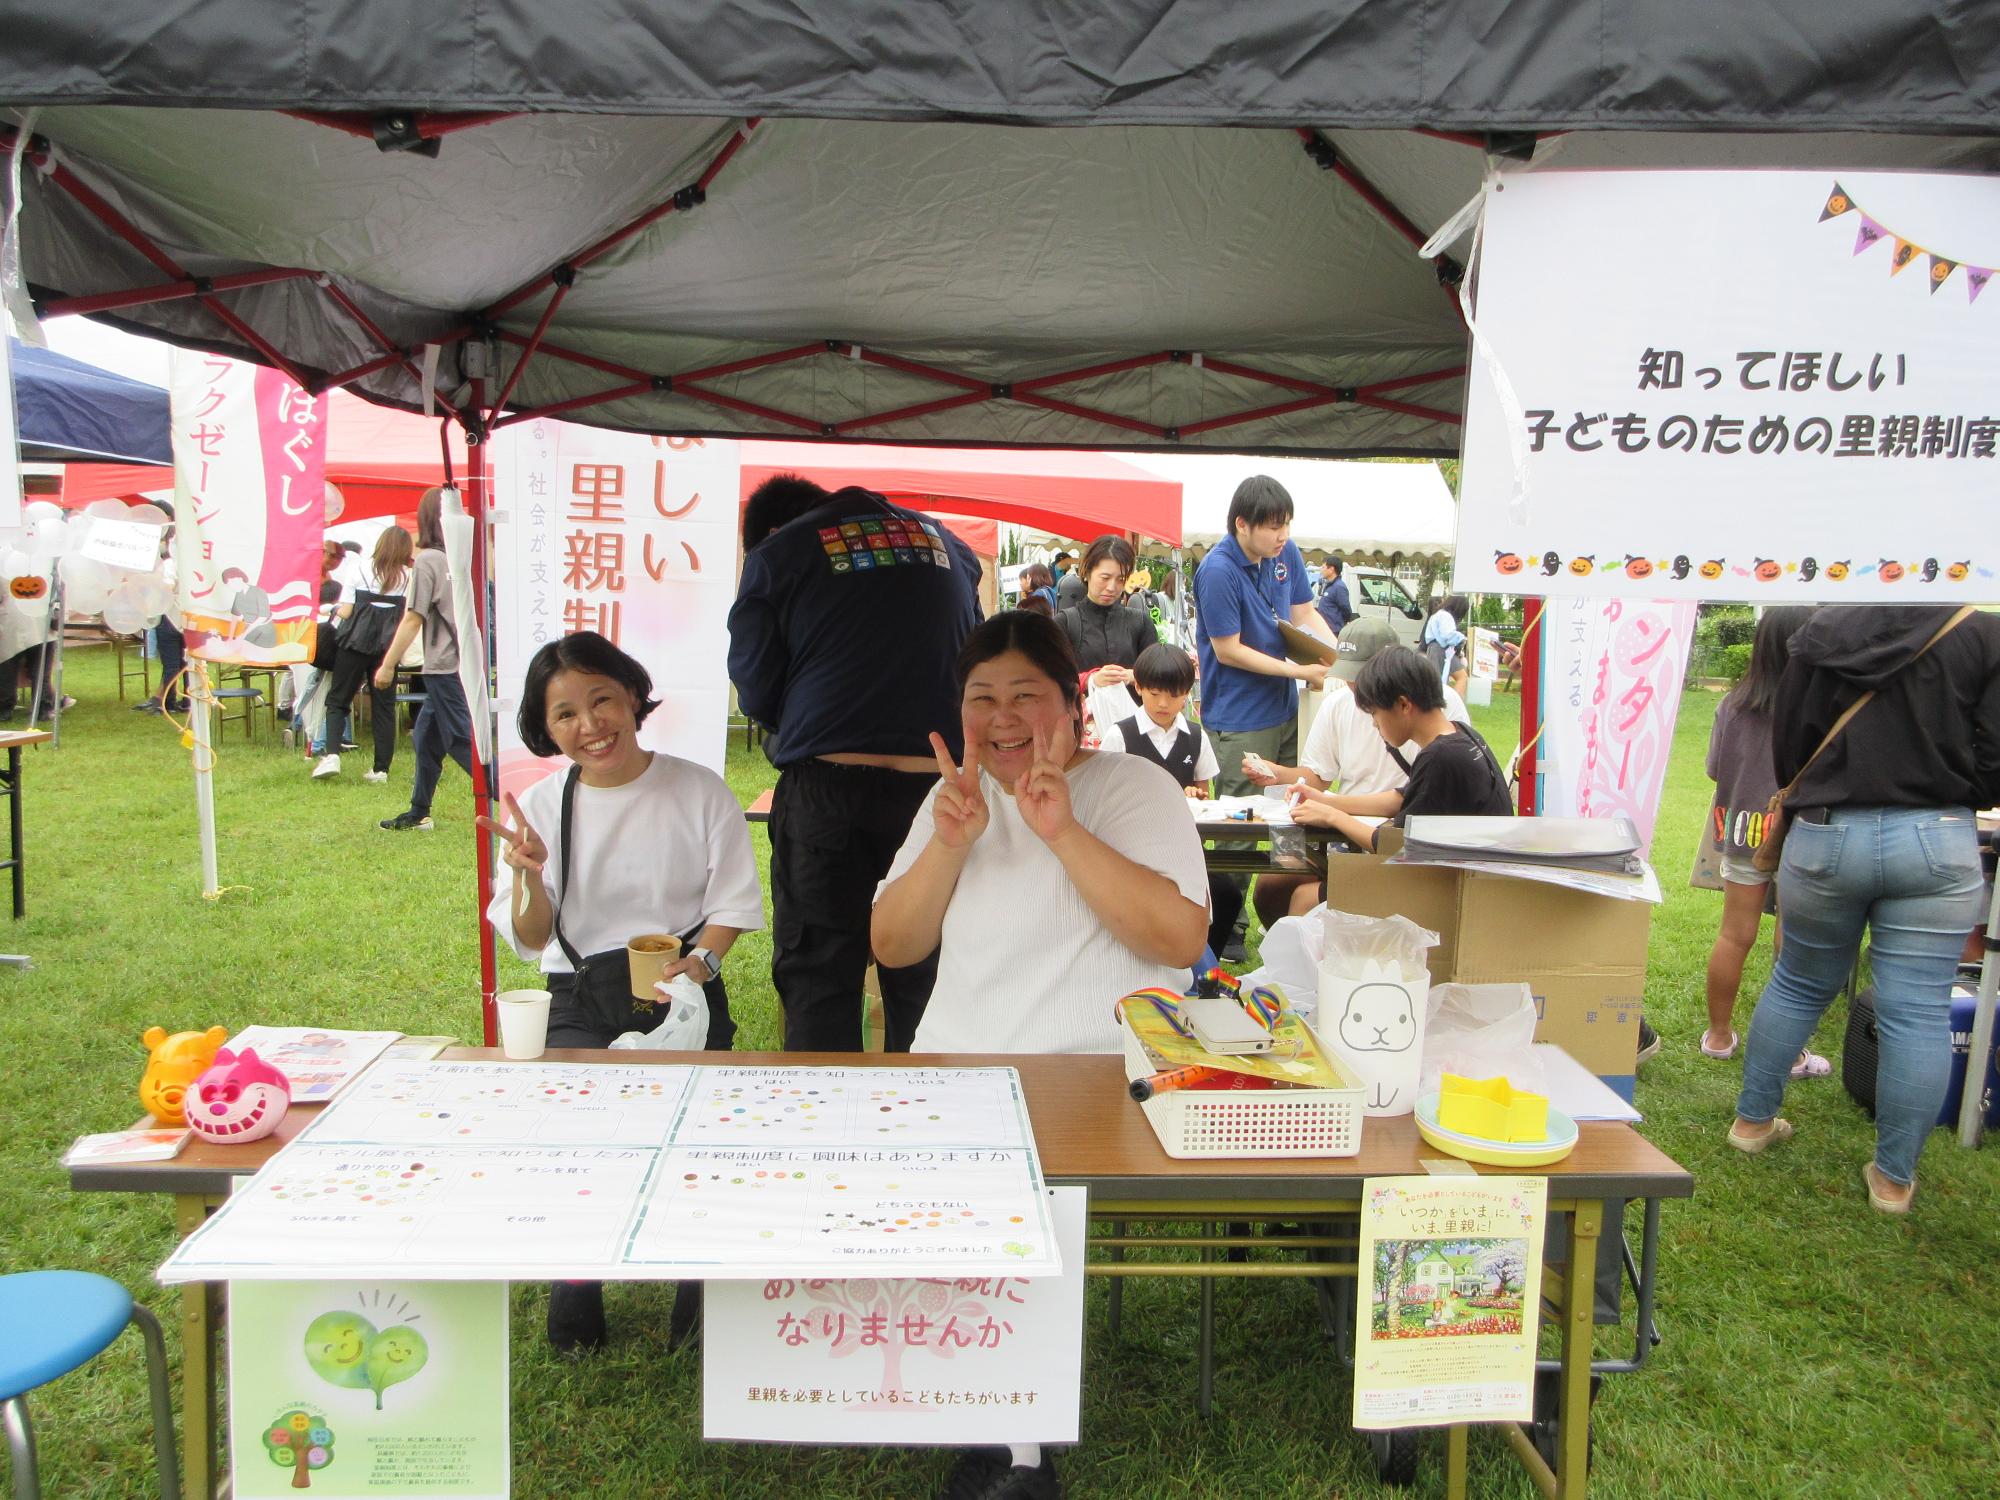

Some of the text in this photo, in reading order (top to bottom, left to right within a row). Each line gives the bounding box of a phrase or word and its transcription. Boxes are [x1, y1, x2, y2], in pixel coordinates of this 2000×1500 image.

[1638, 347, 1906, 392] 知ってほしい
[1523, 410, 2000, 460] 子どものための里親制度
[1618, 598, 1676, 791] ンター
[514, 1166, 591, 1174] チラシを見て
[686, 1151, 1013, 1163] 里親制度に興味はありますか
[776, 1312, 1014, 1348] なりませんか
[747, 1386, 1039, 1406] 里親を必要としているこどもたちがいます
